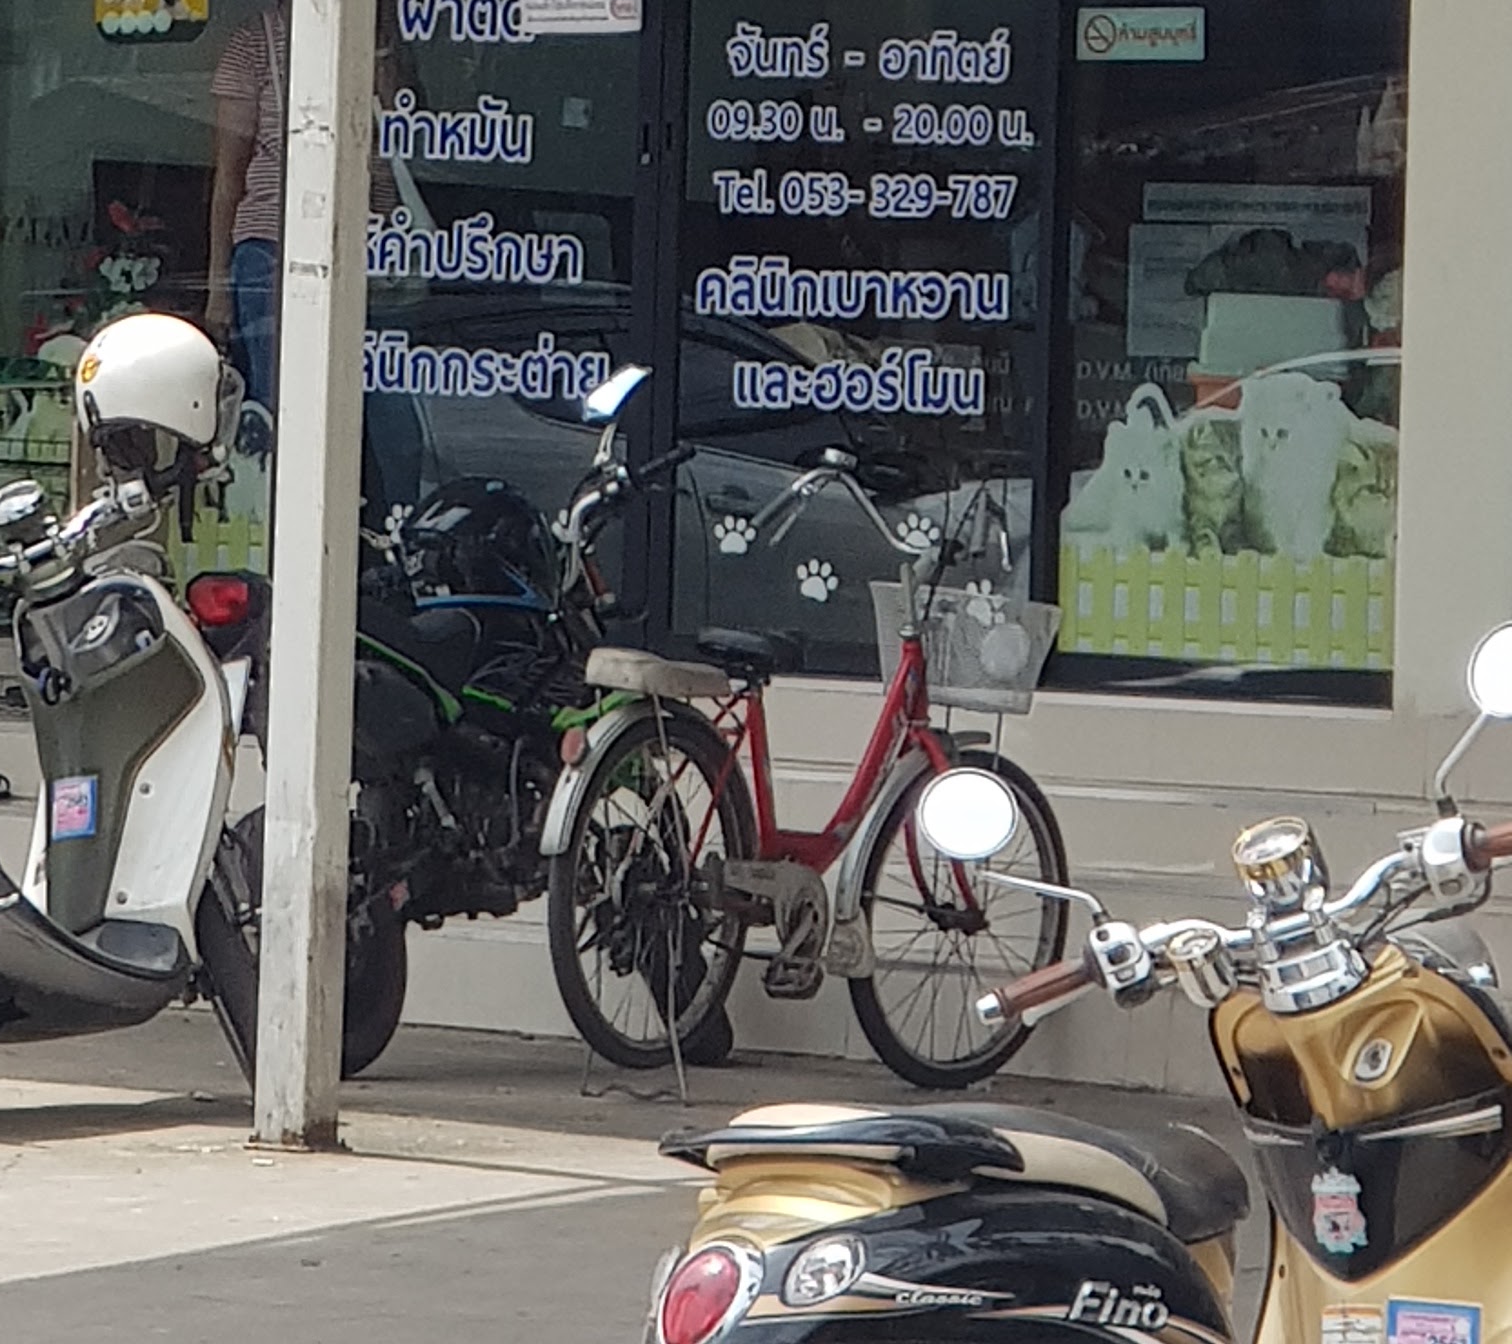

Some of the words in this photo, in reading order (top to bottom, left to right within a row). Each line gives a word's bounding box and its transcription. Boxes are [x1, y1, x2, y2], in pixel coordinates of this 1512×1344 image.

[727, 21, 829, 78] จันทร์
[879, 28, 1010, 83] อาทิตย์
[380, 88, 533, 163] ทำหมัน
[707, 99, 803, 142] 09.30
[810, 106, 845, 143] น.
[892, 103, 993, 145] 20.00
[998, 109, 1034, 146] น.
[713, 169, 775, 215] Tel.
[696, 255, 1010, 322] คลินิกเบาหวาน
[733, 346, 985, 416] และฮอร์โมน
[1068, 1279, 1170, 1330] Fino
